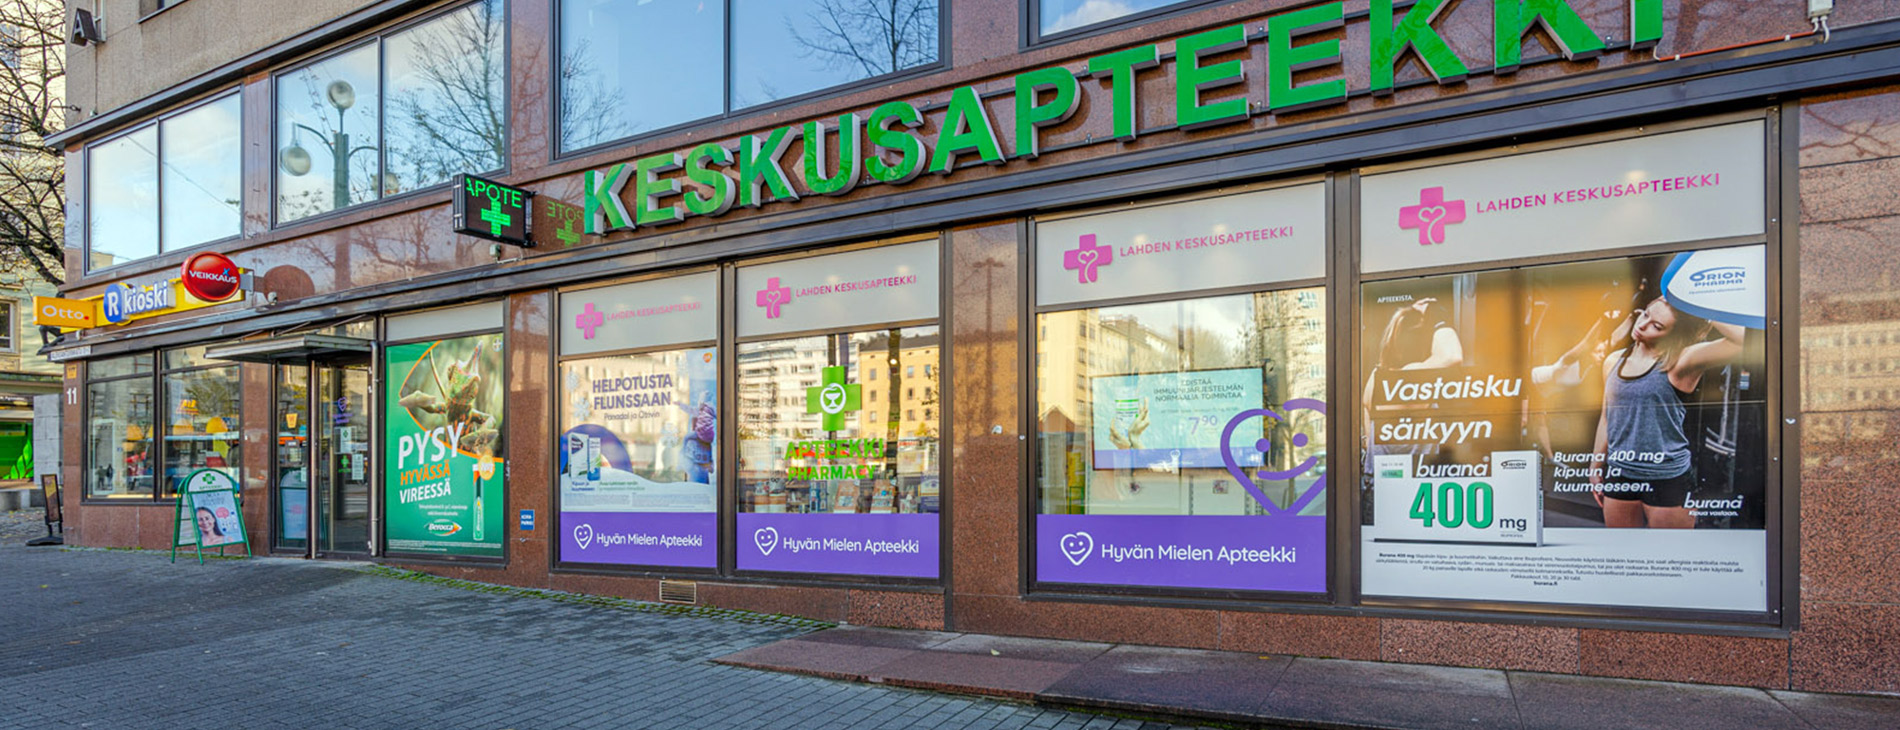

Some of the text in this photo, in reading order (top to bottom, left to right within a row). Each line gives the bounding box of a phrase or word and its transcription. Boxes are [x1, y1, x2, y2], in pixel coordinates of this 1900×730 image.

[465, 178, 522, 208] APOTE
[1477, 173, 1720, 214] LAHDEN KESKUSAPTEEKKI
[1120, 226, 1294, 257] LAHDEN KESKUSAPTEEKKI
[189, 270, 237, 284] VEIKKAUS
[1690, 267, 1745, 281] ORION
[1695, 279, 1742, 287] PHARMA
[796, 274, 916, 297] LAHDEN KESKUSAPTEEKKI
[108, 281, 168, 316] R kioski
[606, 302, 702, 321] LAHDEN KESKUSAPTEEKKI
[592, 374, 673, 393] HELPOTUSTA
[1382, 375, 1522, 401] Vastaisku
[66, 387, 77, 404] 11
[594, 392, 671, 410] FLUNSSAAN
[604, 412, 629, 420] Panadol
[1380, 418, 1492, 444] särkyyn
[398, 422, 465, 469] PYSY
[784, 438, 884, 460] APTEEKKI
[1416, 454, 1490, 478] burana
[1554, 450, 1664, 463] Burana 400 mg
[400, 460, 450, 486] HYVÄSSÄ
[788, 465, 876, 481] PHARMACY
[1554, 466, 1621, 479] kipuun ja
[400, 478, 451, 504] VIREESSÄ
[1554, 481, 1653, 492] kuumeeseen.
[1409, 482, 1527, 532] 400 mg
[1684, 492, 1744, 509] burana
[596, 533, 702, 548] Hyvän Mielen Apteekki
[783, 537, 919, 555] Hyvän Mielen Apteekki
[1101, 544, 1296, 566] Hyvän Mielen Apteekki
